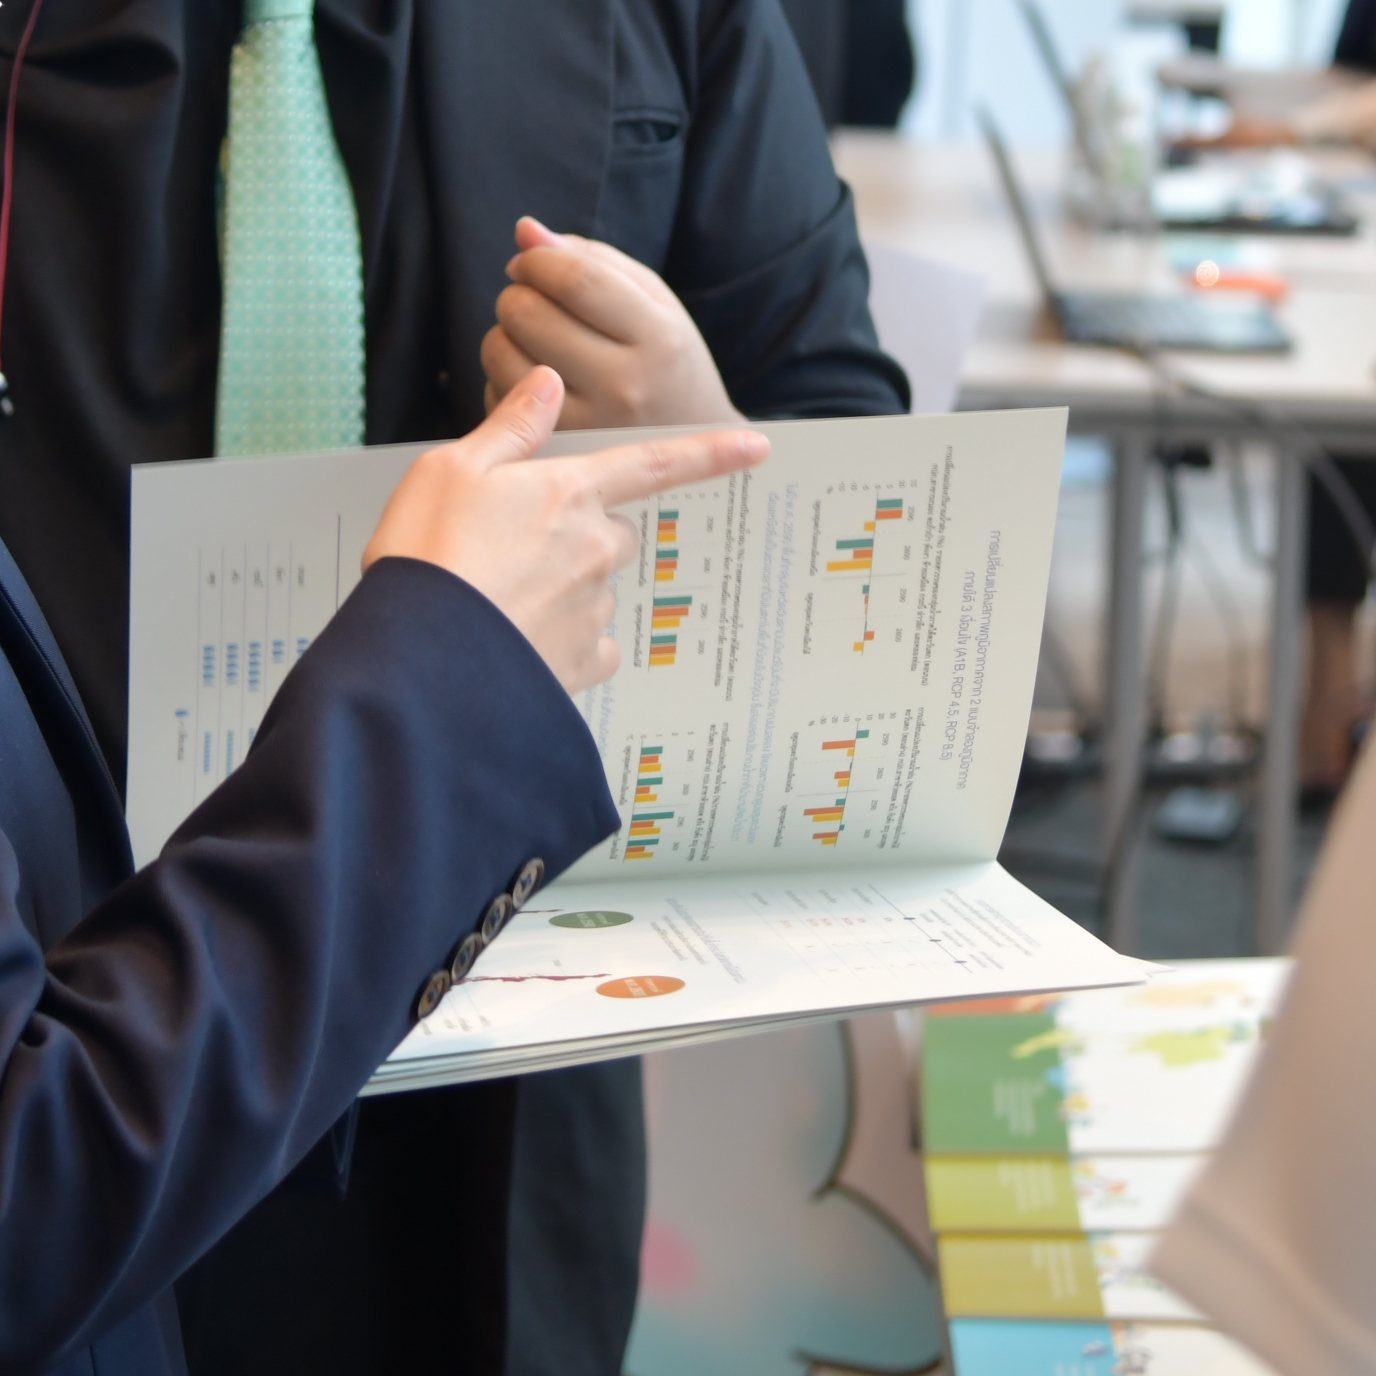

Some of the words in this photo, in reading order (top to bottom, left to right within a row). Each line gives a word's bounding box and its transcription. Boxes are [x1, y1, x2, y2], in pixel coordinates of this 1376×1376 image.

[963, 571, 977, 603] ภายใต้
[972, 530, 1003, 696] การเปลี่ยนแปลงสภาพภูมิอากาศจาก
[957, 615, 976, 645] เงื่อนไข
[952, 648, 967, 674] (A1B,
[951, 677, 964, 699] RCP
[946, 701, 960, 719] 4.5,
[945, 721, 958, 742] RCP
[939, 744, 954, 761] 8.5)
[957, 707, 980, 789] แบบจำลองภูมิอากาศ
